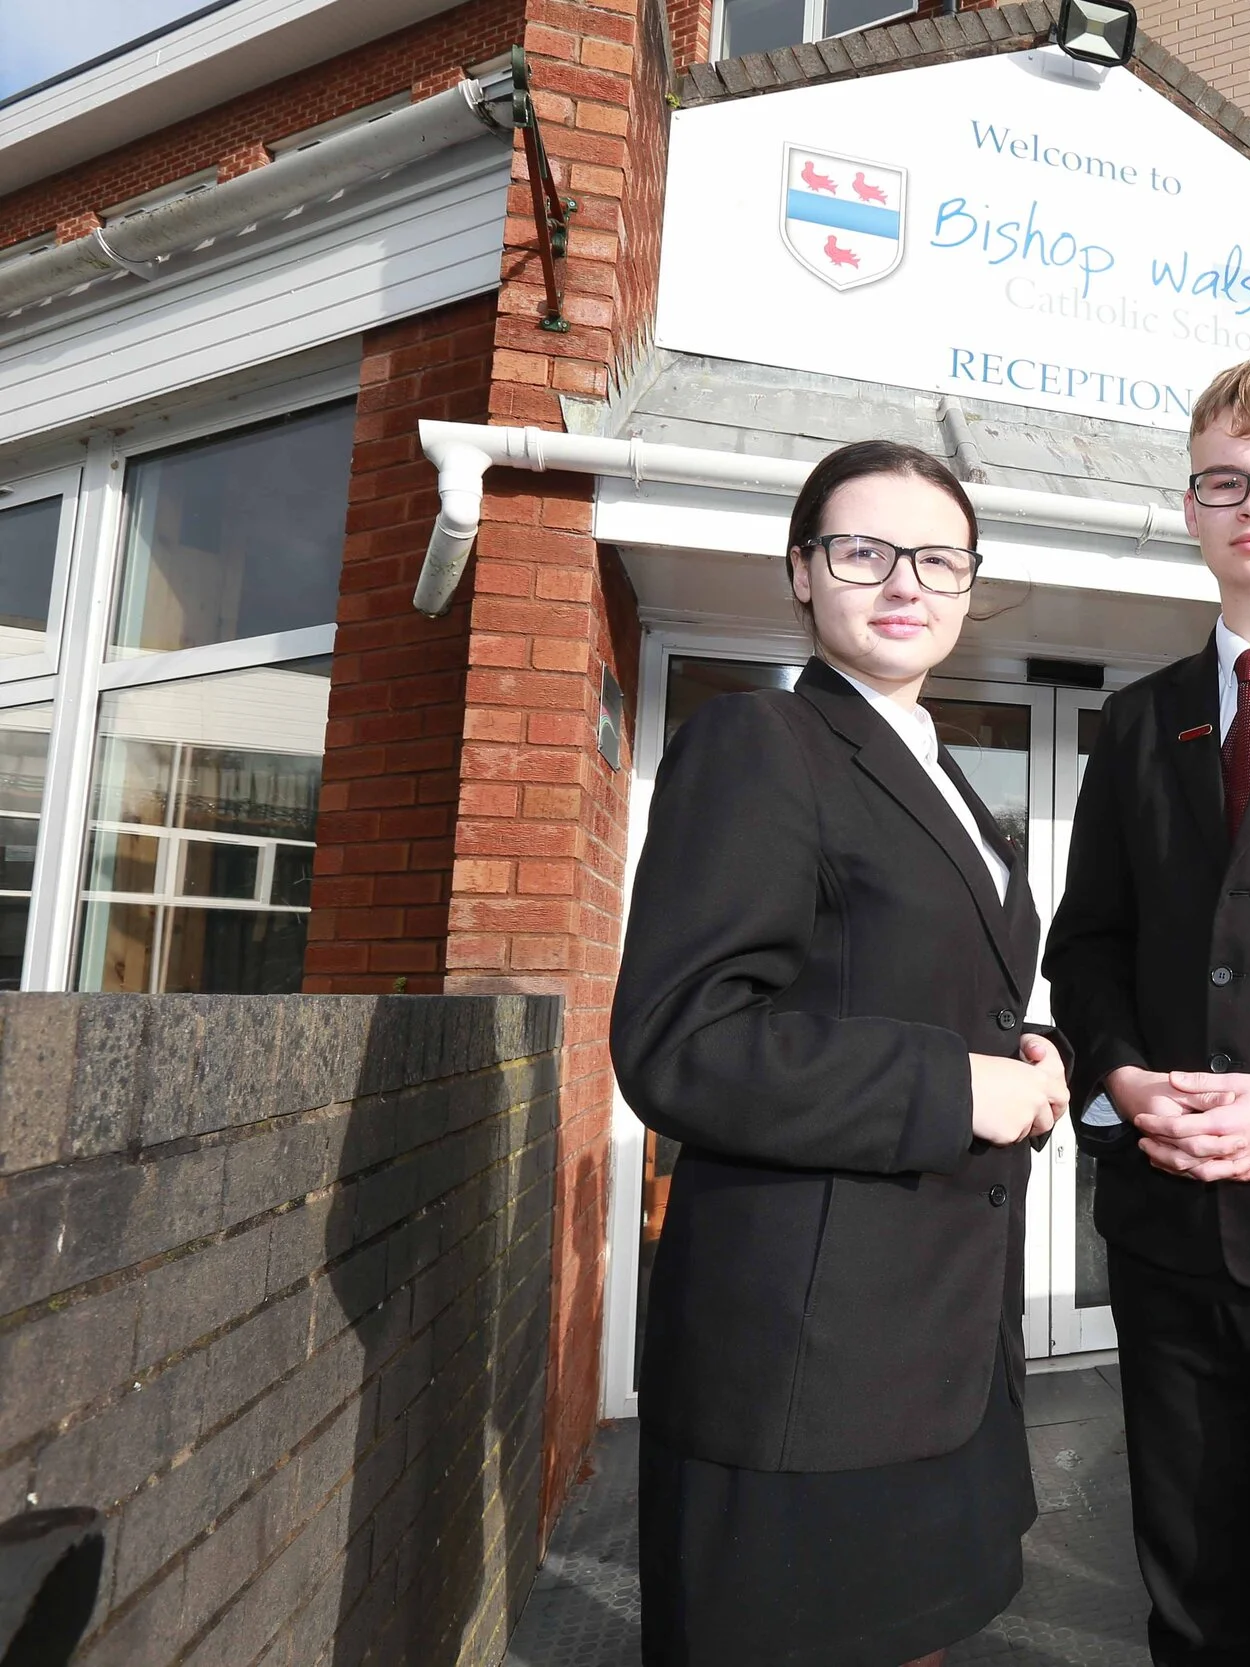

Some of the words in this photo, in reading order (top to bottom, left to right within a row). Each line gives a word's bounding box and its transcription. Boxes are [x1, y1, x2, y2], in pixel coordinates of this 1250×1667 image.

[971, 119, 1138, 186] Welcome
[1150, 167, 1182, 196] to
[930, 197, 1115, 299] Bishop
[1004, 276, 1159, 334] Catholic
[948, 347, 1193, 418] RECEPTION
